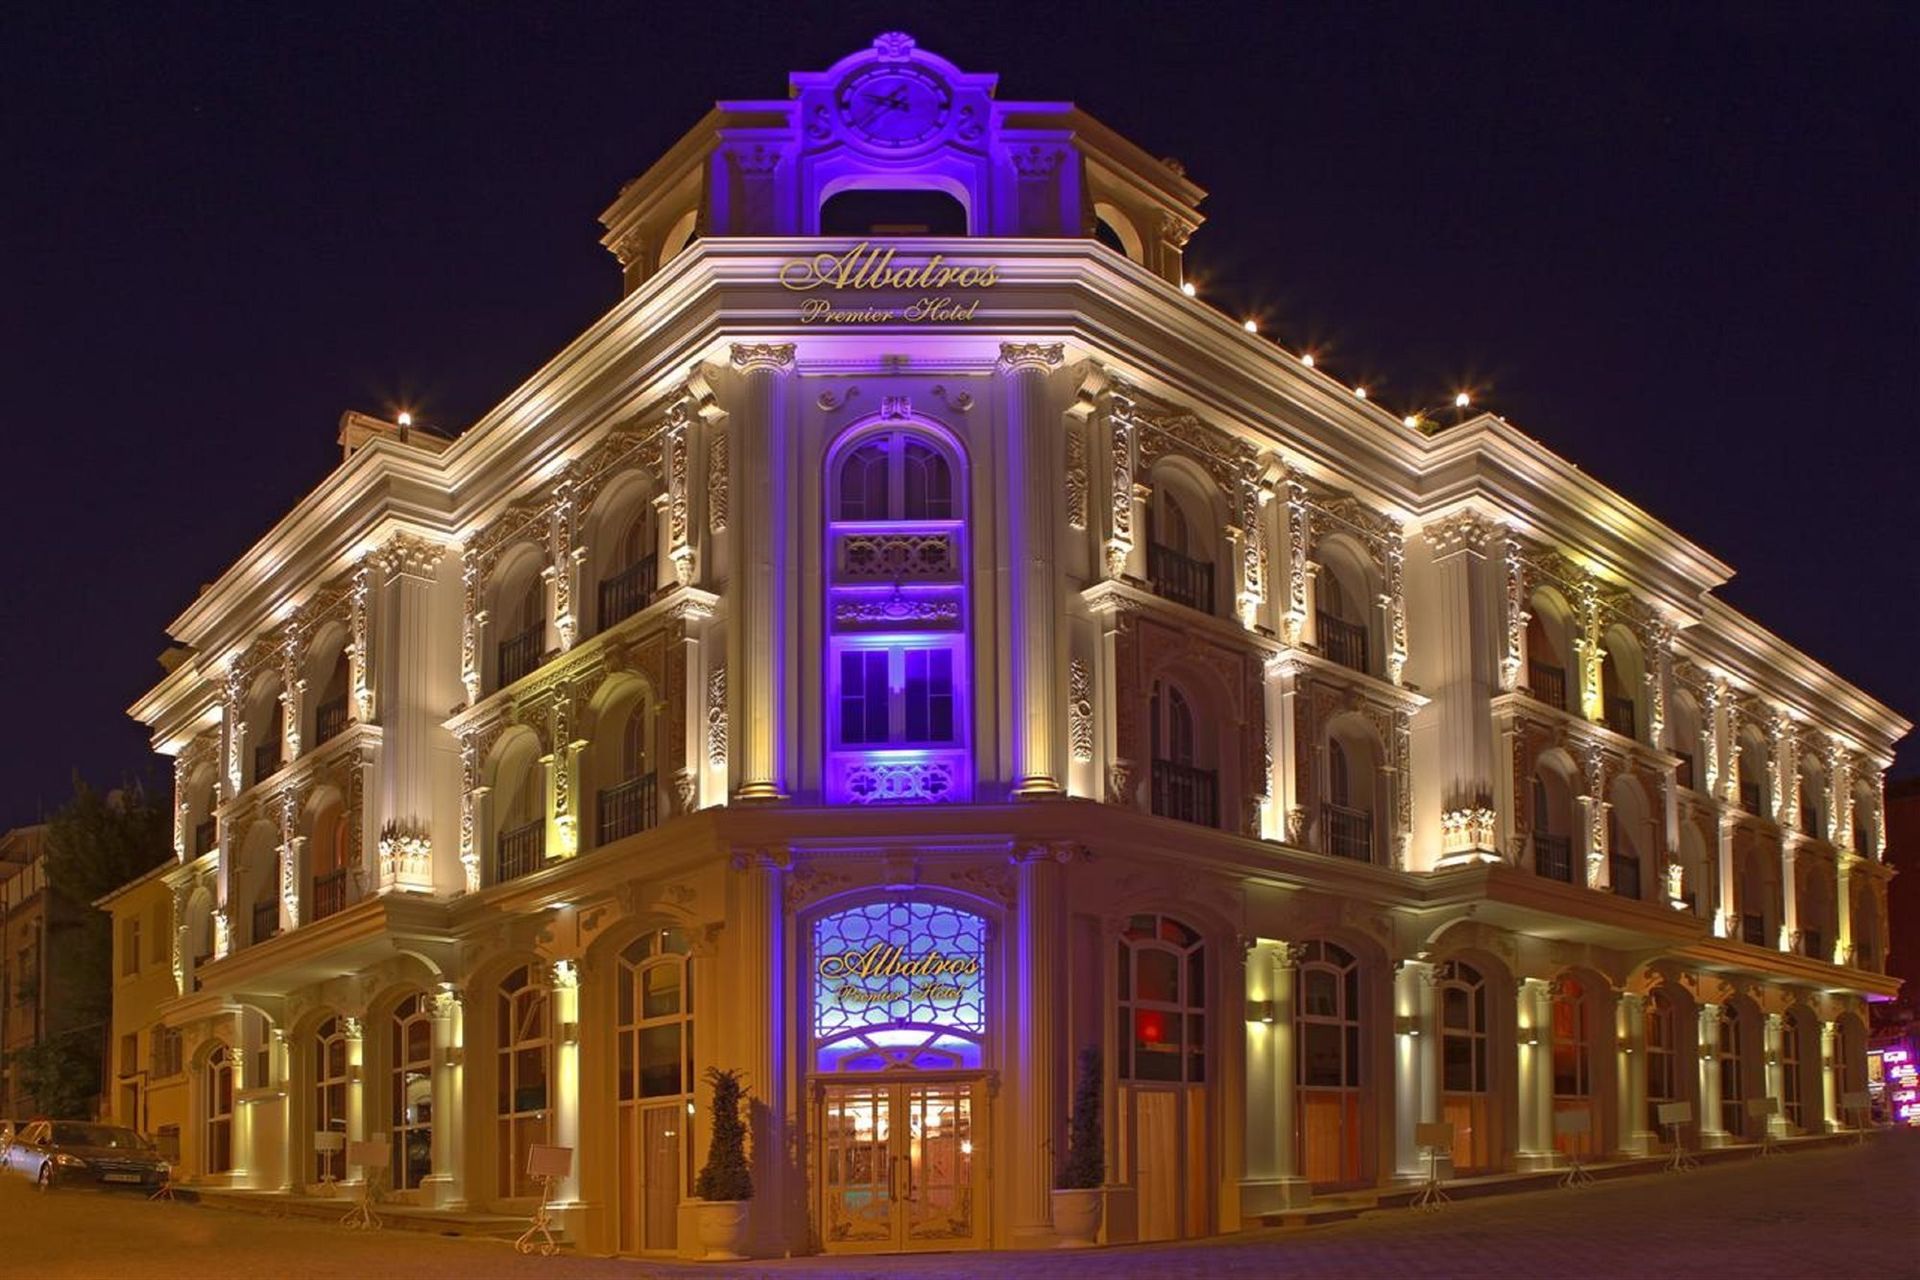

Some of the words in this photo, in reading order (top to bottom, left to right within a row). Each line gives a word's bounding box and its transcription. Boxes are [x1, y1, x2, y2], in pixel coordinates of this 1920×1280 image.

[779, 242, 999, 290] Albatros
[801, 298, 894, 323] Premier
[903, 297, 980, 322] Hotel
[819, 942, 980, 979] Albatros
[836, 984, 905, 1002] Premier
[910, 982, 964, 1000] Hotel
